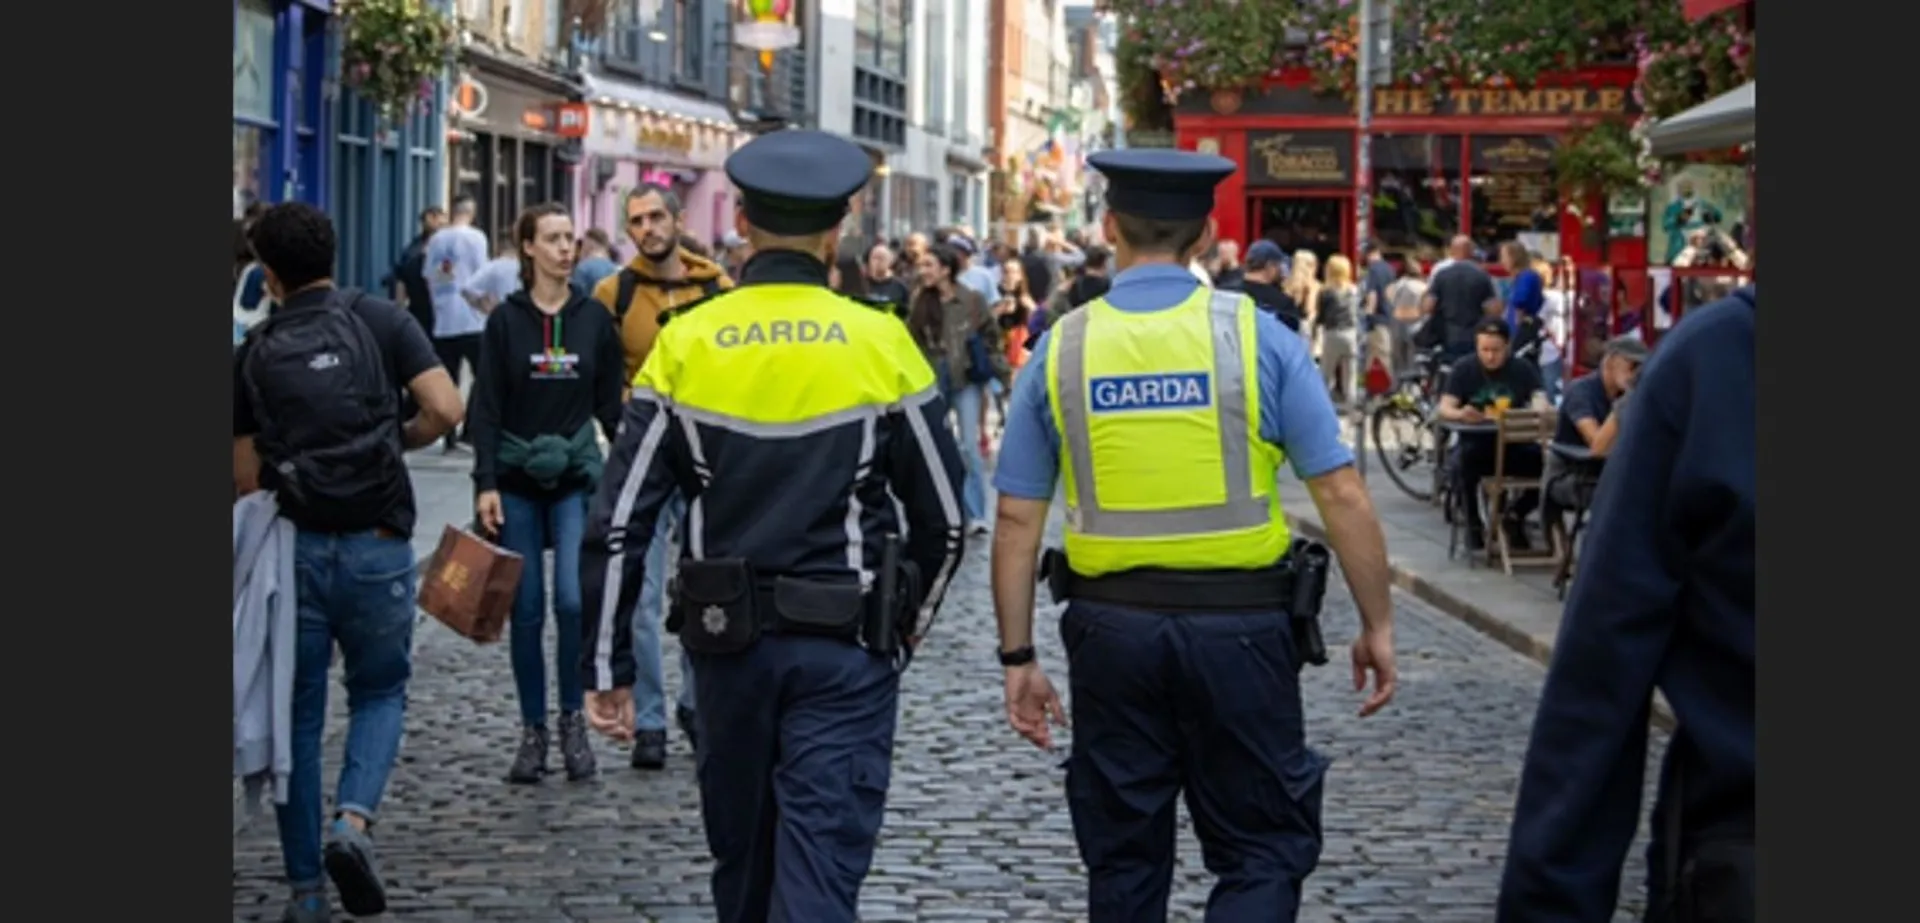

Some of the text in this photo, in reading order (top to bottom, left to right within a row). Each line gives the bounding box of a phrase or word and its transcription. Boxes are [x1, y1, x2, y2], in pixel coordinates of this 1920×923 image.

[1450, 87, 1625, 115] TEMPLE
[714, 319, 849, 348] GARDA
[1095, 378, 1205, 406] GARDA
